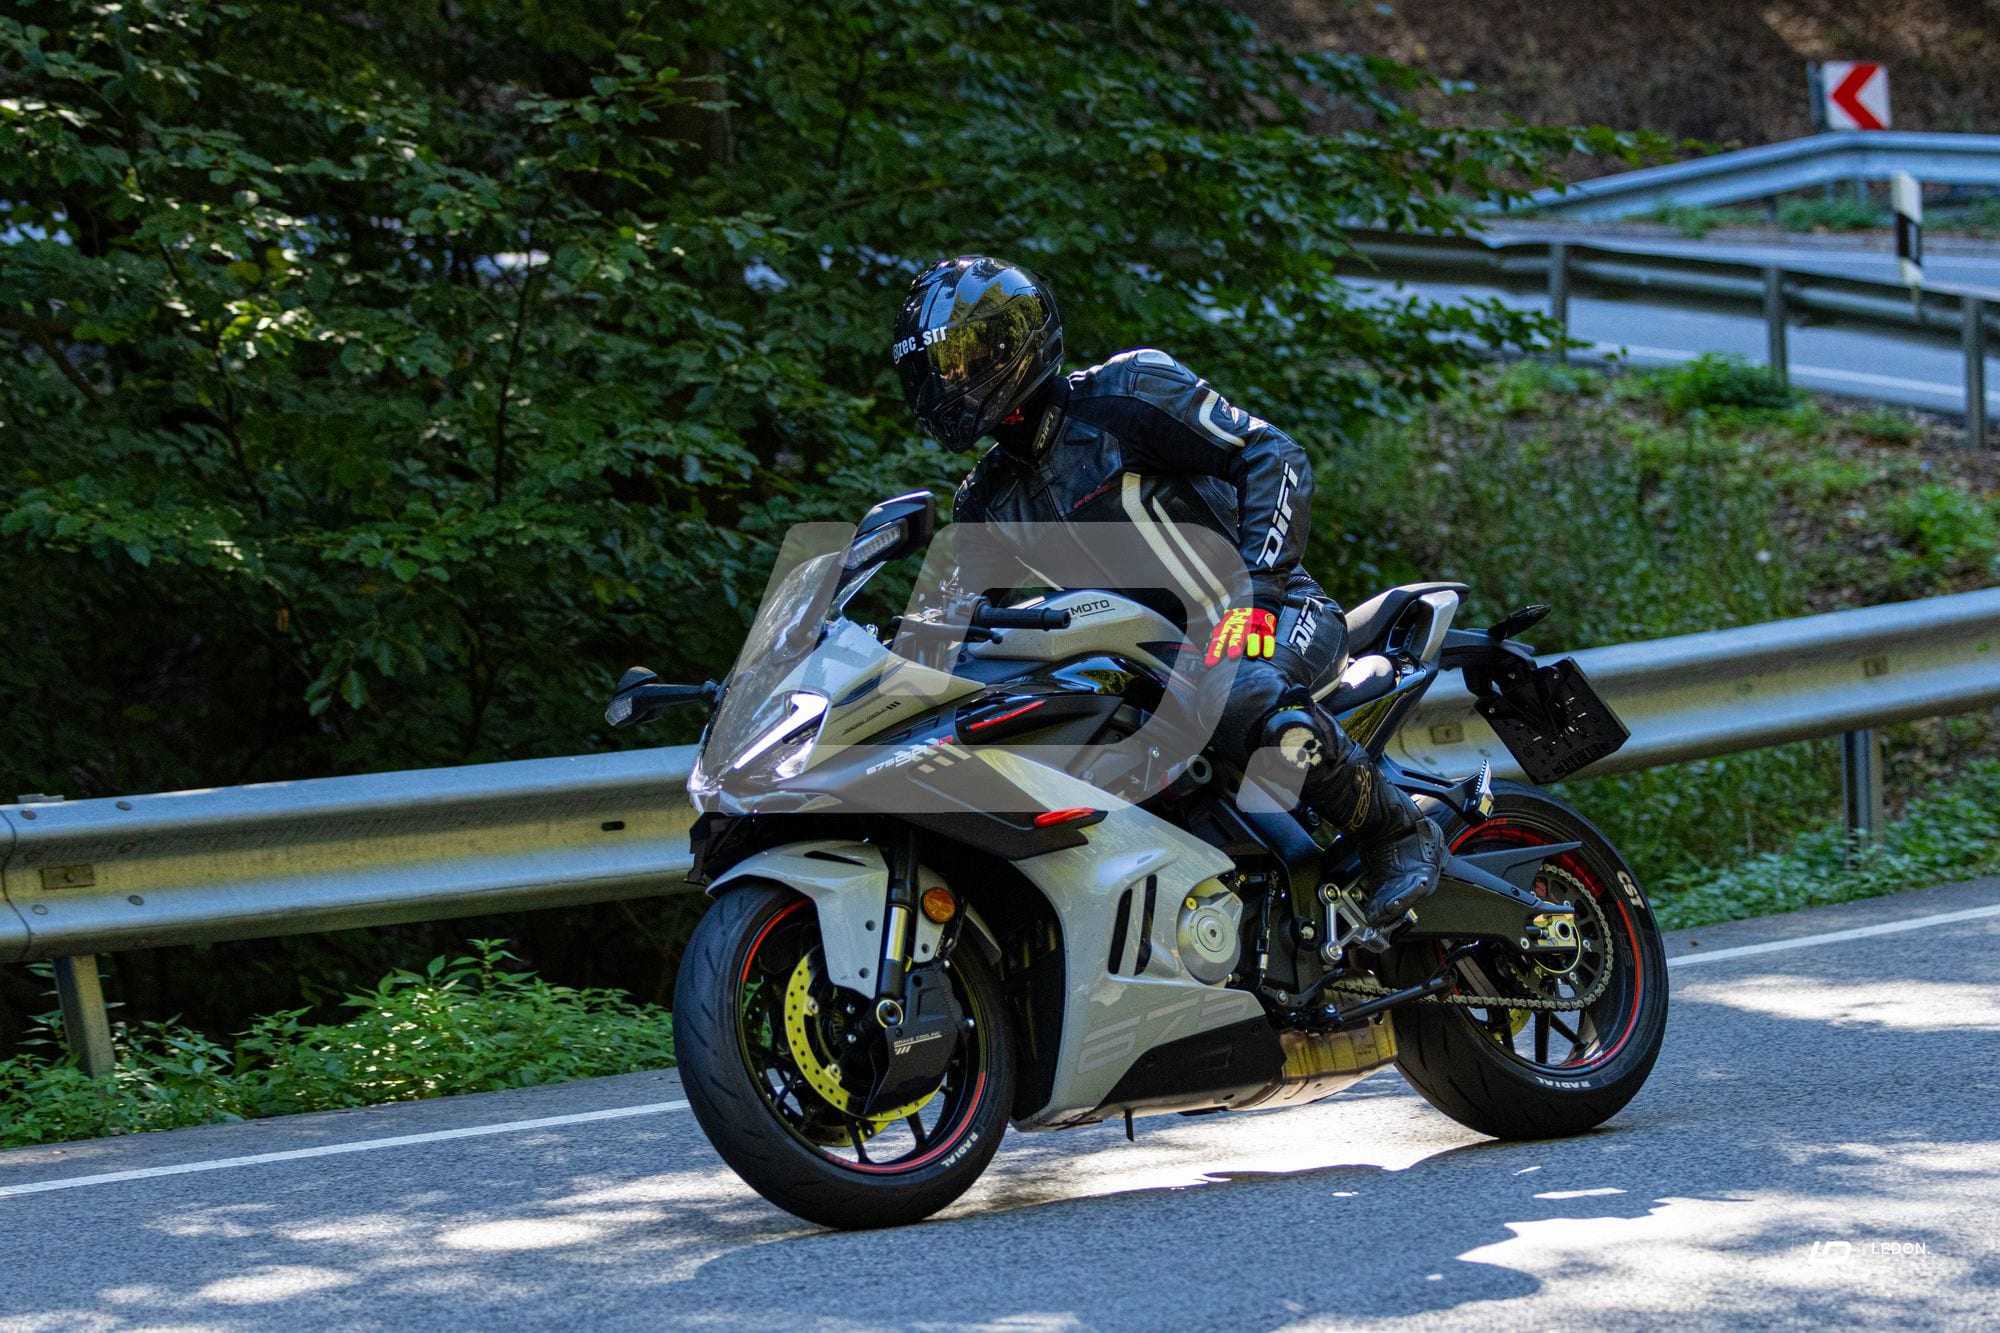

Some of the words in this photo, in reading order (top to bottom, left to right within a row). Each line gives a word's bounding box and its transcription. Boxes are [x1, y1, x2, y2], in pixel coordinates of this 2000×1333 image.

[1617, 870, 1645, 910] CST
[1078, 989, 1251, 1076] 675
[1536, 1076, 1591, 1089] RADIAL
[941, 1132, 979, 1167] RADIAL
